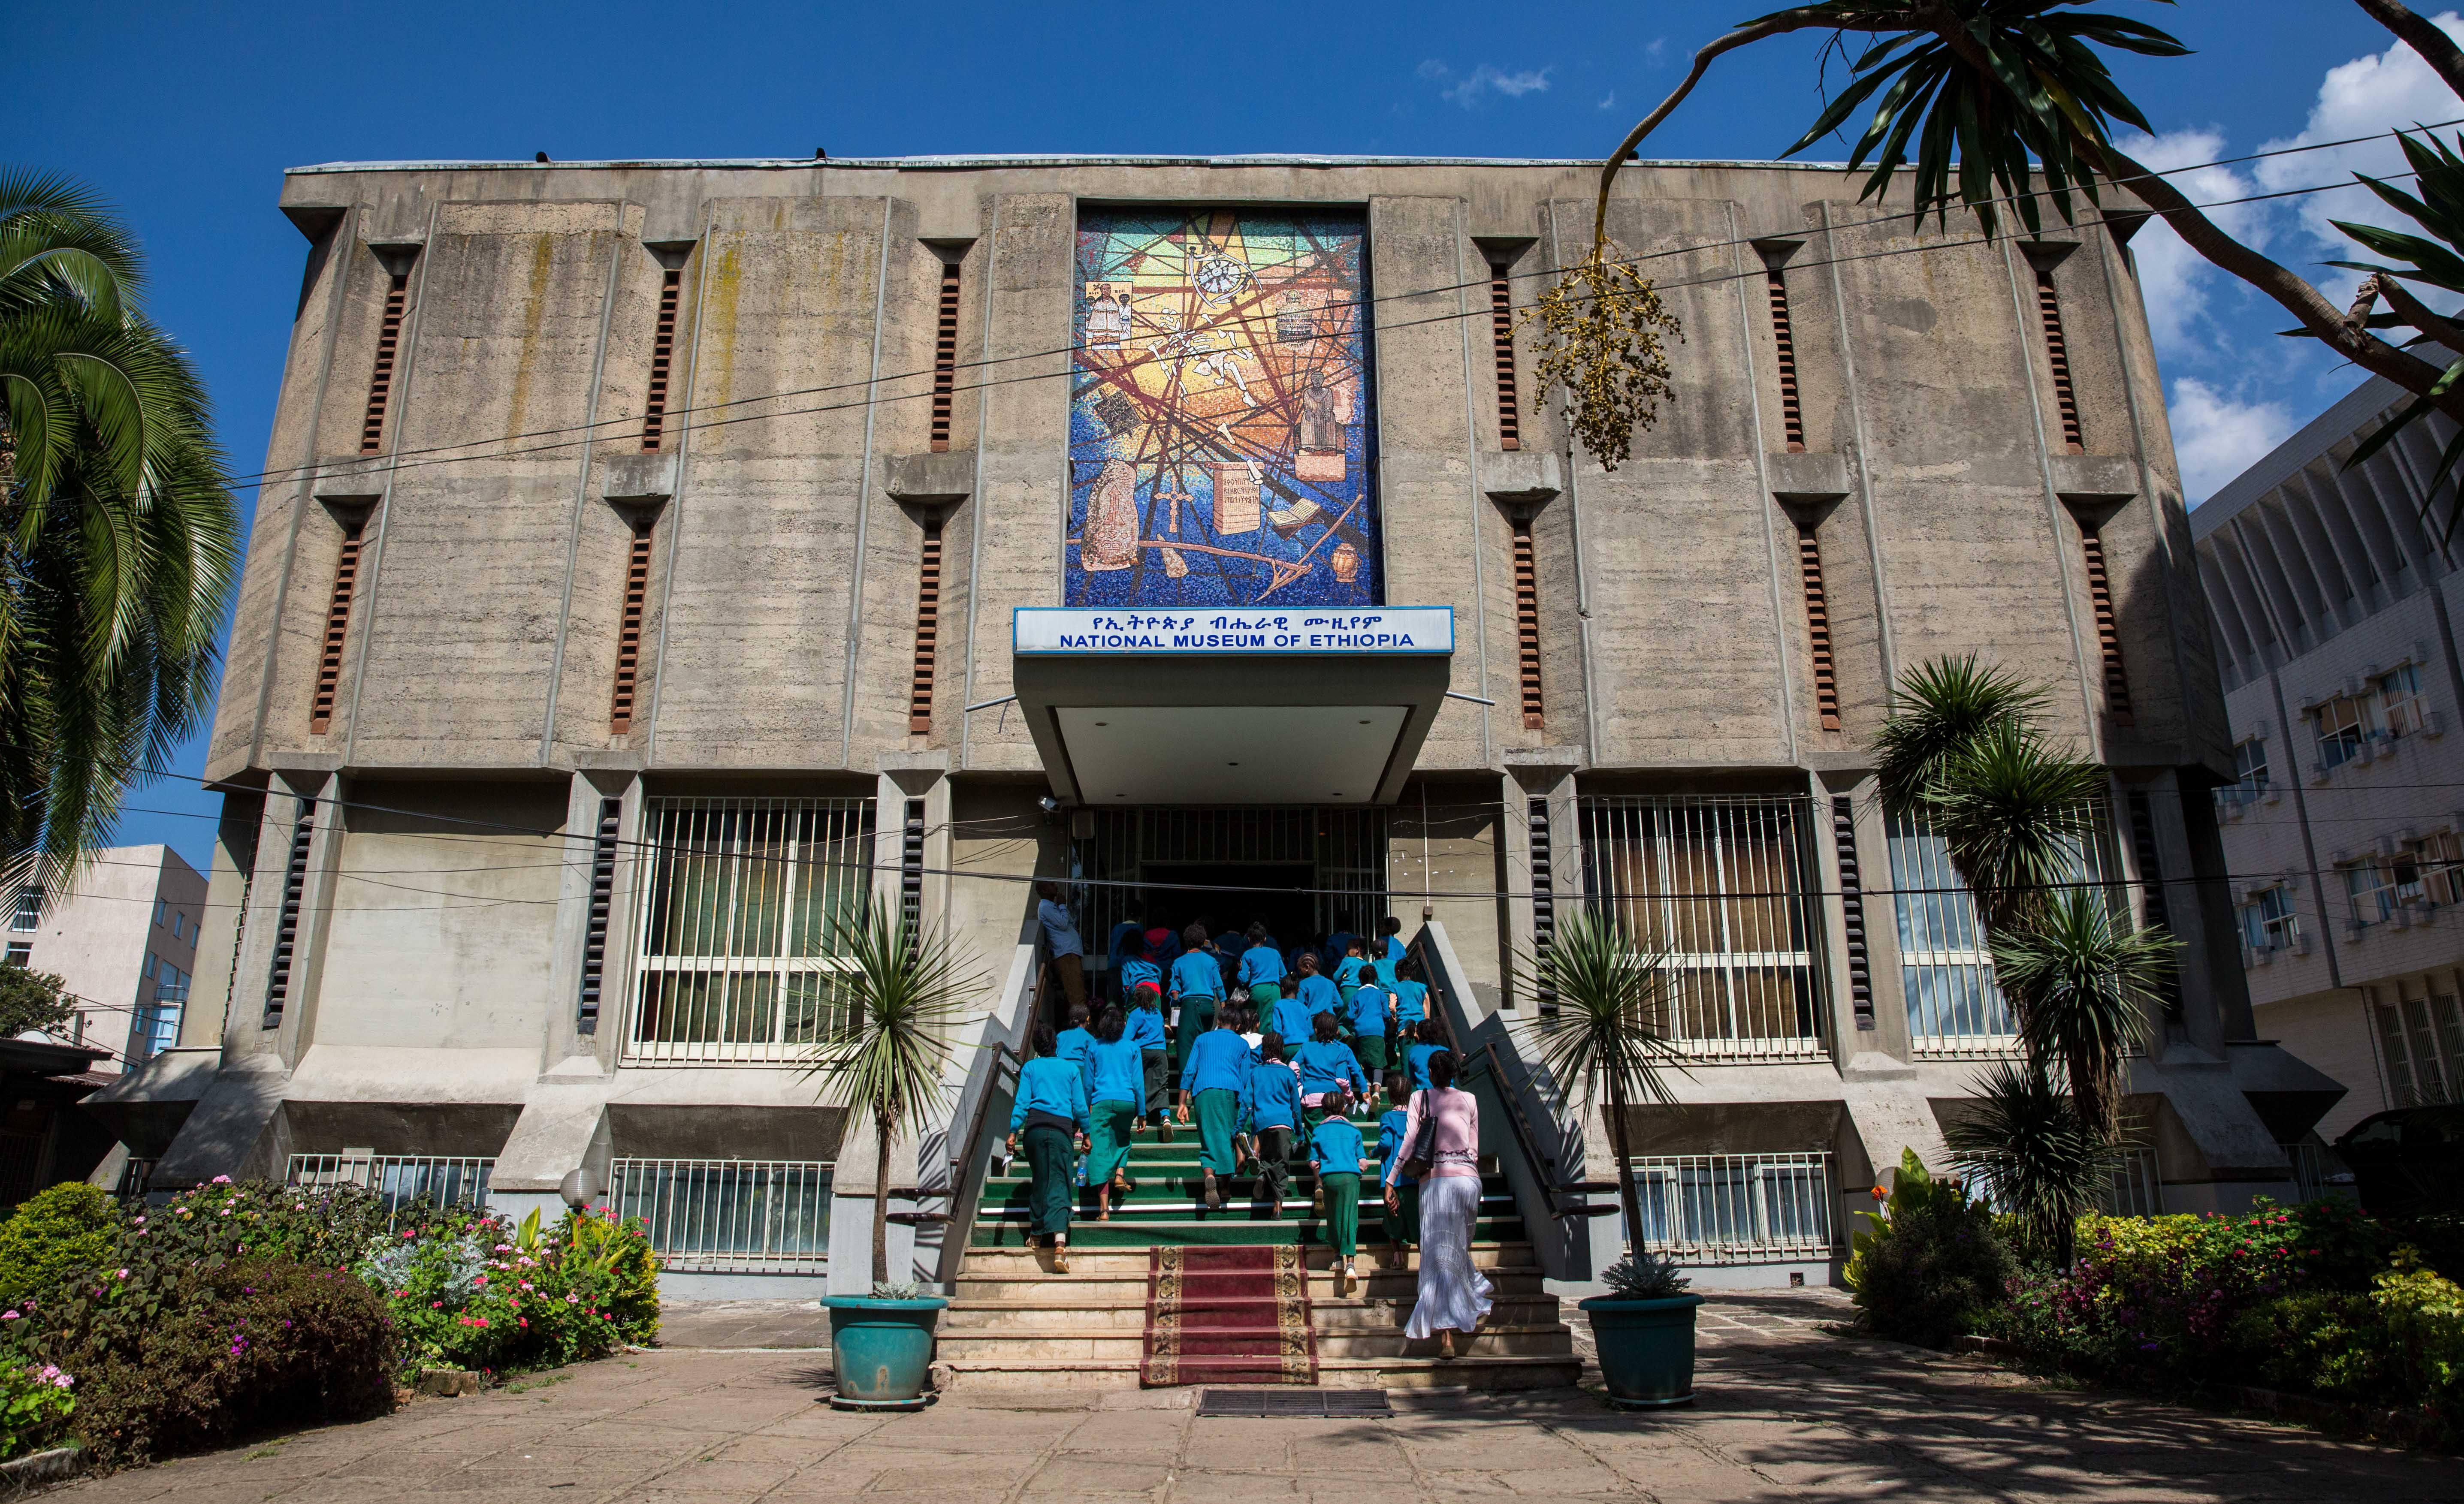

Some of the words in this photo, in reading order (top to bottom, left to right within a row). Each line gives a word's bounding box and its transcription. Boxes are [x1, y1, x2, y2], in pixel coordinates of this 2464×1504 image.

[1093, 615, 1195, 631] የኢትዮጵያ
[1210, 616, 1288, 631] ብሔራዊ
[1304, 616, 1382, 630] ሙዚየም
[1060, 635, 1166, 647] NATIONAL
[1173, 635, 1265, 647] MUSEUM
[1274, 635, 1301, 647] OF
[1310, 634, 1414, 647] ETHIOPIA
